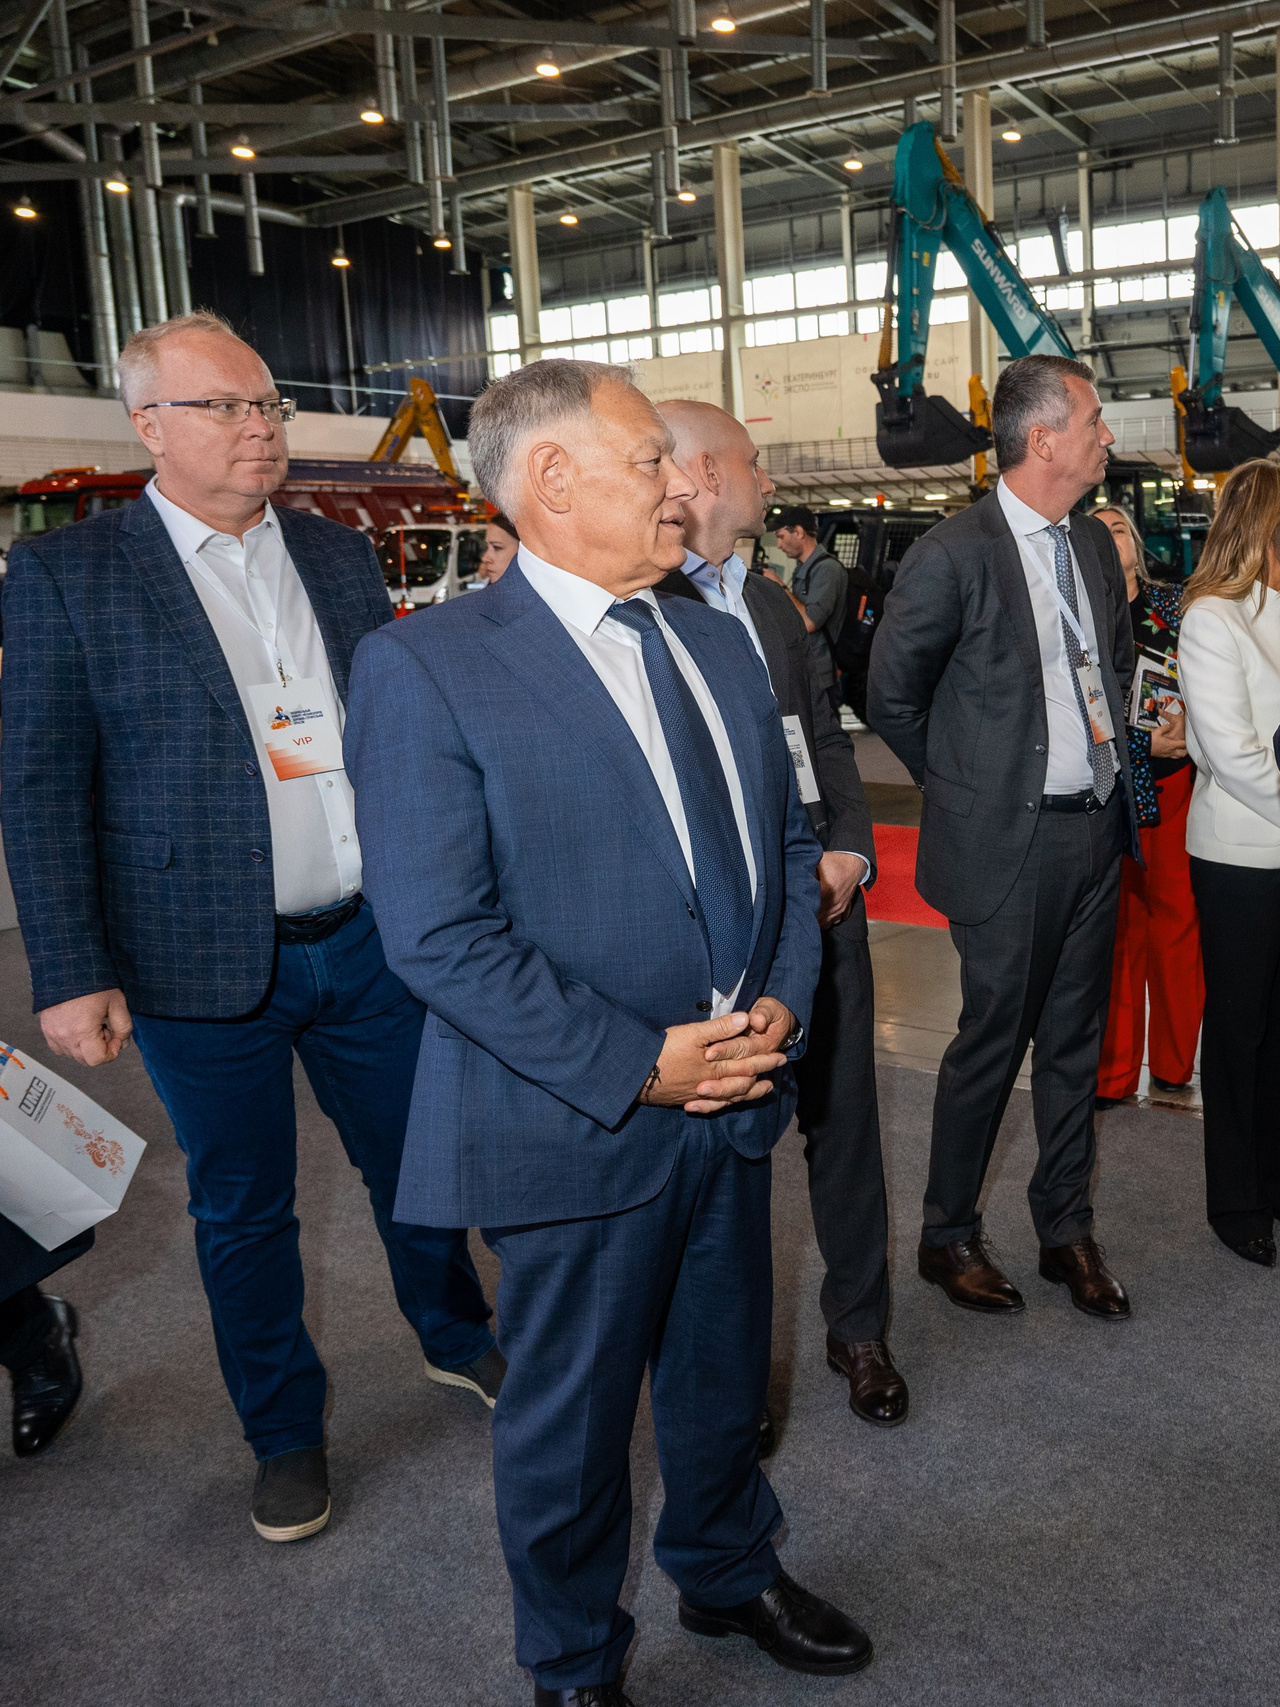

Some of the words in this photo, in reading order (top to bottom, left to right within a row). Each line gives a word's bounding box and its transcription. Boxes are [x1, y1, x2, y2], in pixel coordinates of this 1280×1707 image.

[970, 237, 1027, 320] SUNWARD
[782, 369, 838, 385] ЕКАТЕРИНБУРГ
[292, 736, 313, 746] VIP
[20, 1077, 47, 1116] UMG
